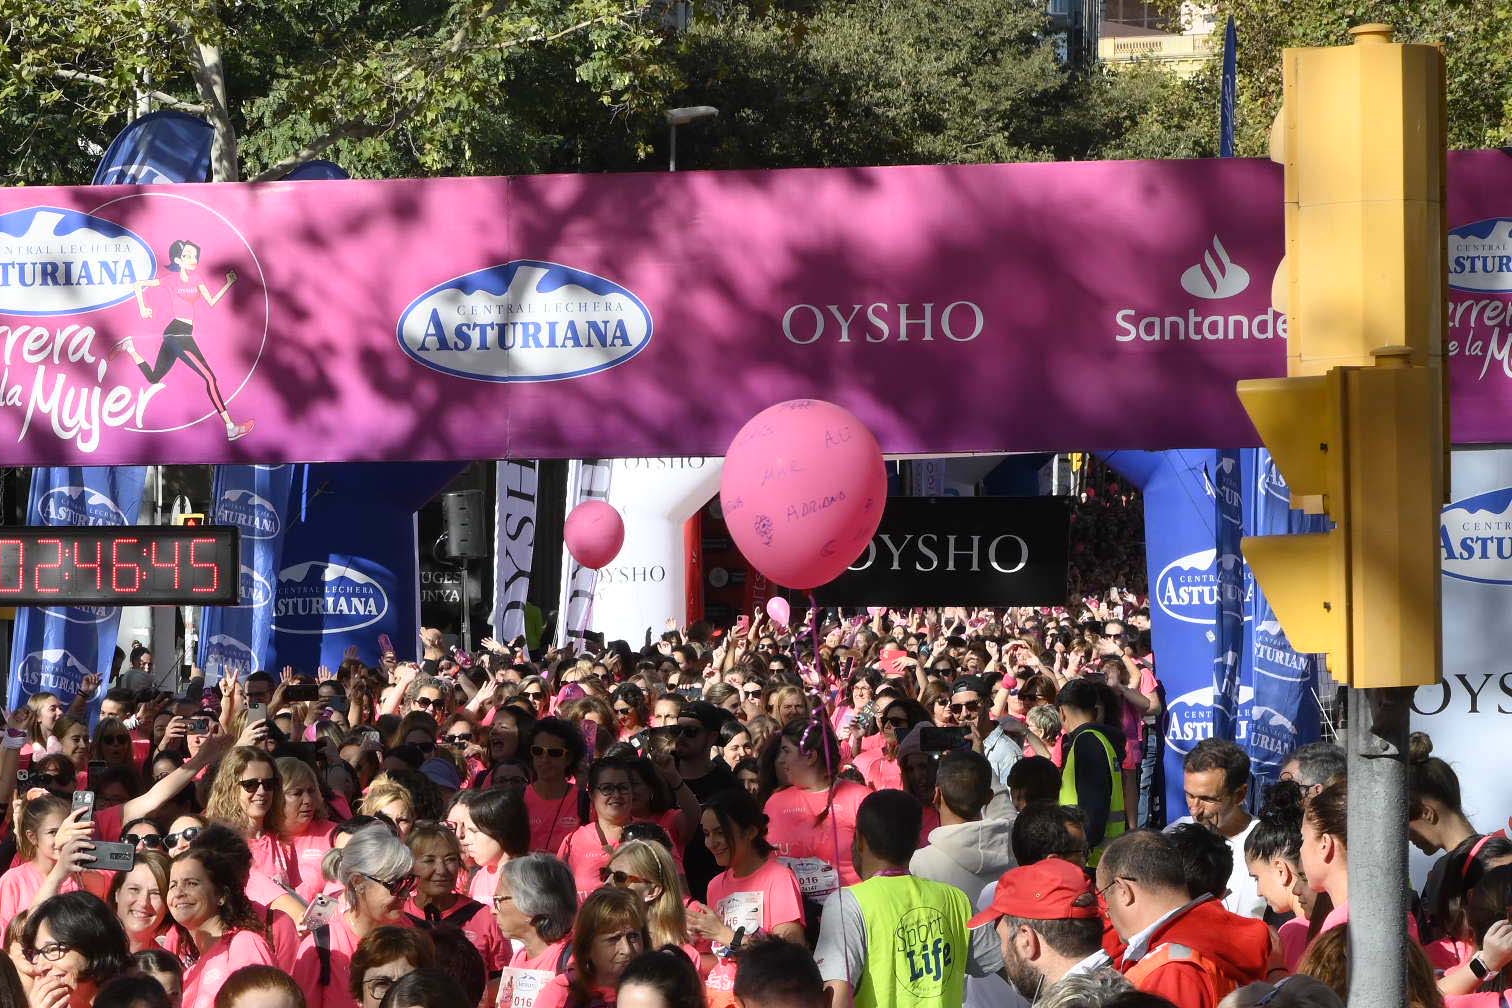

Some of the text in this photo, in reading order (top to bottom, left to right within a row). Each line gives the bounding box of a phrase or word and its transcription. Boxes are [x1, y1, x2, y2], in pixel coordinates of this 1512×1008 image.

[457, 301, 625, 315] CENTRAL LECHERA
[782, 301, 985, 345] OYSHO
[1115, 306, 1288, 342] Santande
[417, 308, 633, 352] ASTURIANA
[18, 358, 166, 453] Mujer
[273, 596, 378, 617] STURIANA
[897, 913, 944, 952] Sport
[907, 938, 951, 982] Life
